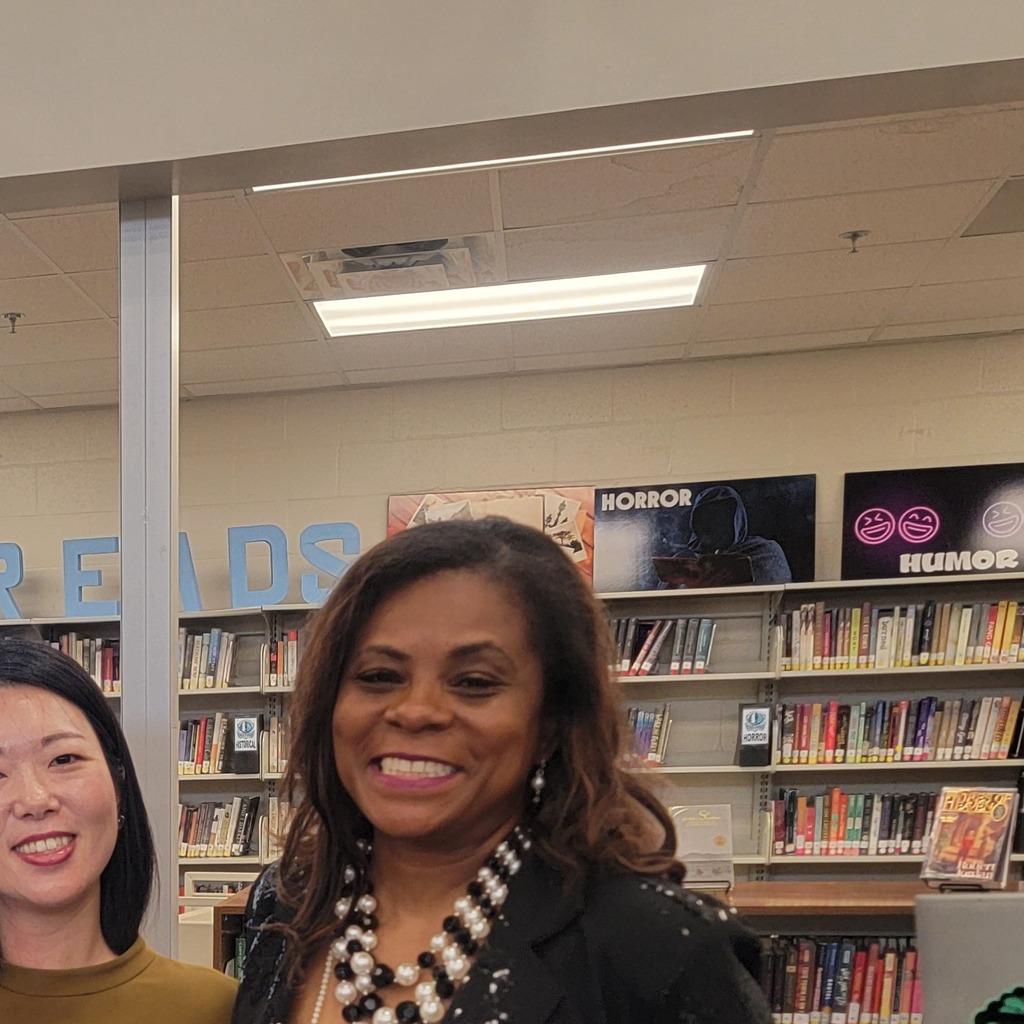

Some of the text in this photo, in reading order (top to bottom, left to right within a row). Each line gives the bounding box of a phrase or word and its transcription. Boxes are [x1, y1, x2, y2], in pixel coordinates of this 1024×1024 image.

[601, 488, 692, 512] HORROR
[899, 549, 1019, 574] HUMOR
[235, 740, 257, 749] HISTORICAL
[743, 732, 767, 743] HORROR
